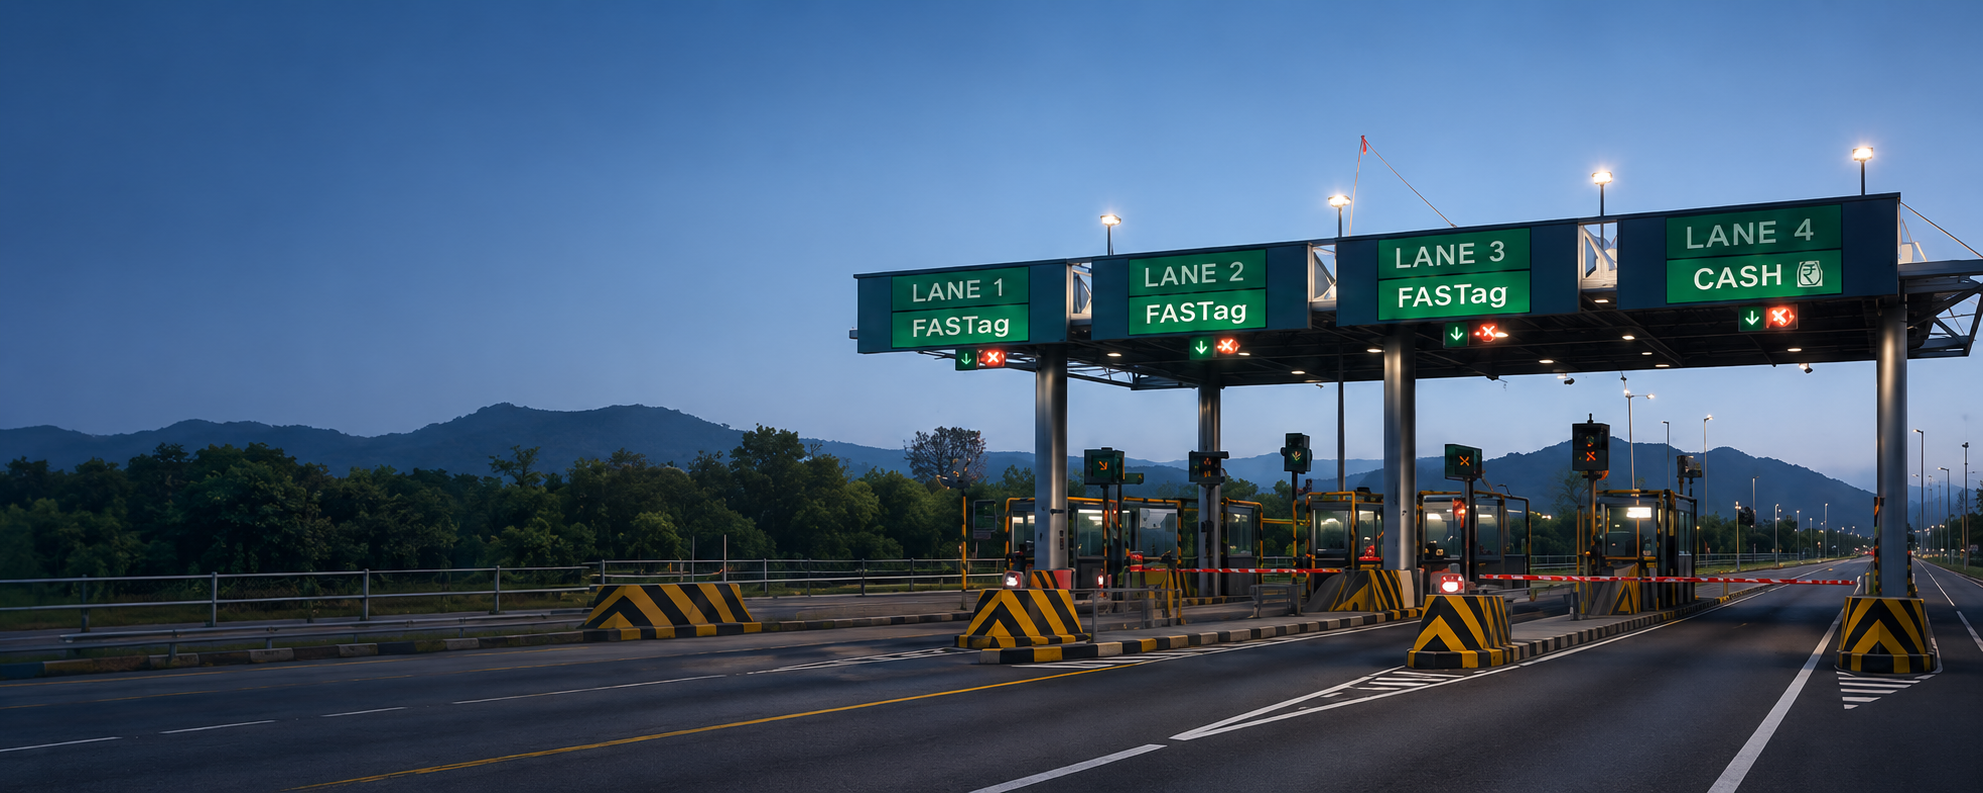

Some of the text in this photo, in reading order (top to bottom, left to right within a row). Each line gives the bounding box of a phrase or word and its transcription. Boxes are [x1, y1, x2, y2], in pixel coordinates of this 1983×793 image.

[1686, 218, 1814, 250] LANE 4
[1395, 240, 1505, 269] LANE 3
[1144, 261, 1244, 288] LANE 2
[1693, 263, 1782, 291] CASH
[912, 277, 1003, 303] LANE 1
[1398, 283, 1509, 309] FASTag
[1146, 300, 1247, 325] FASTag
[912, 315, 1010, 338] FASTag
